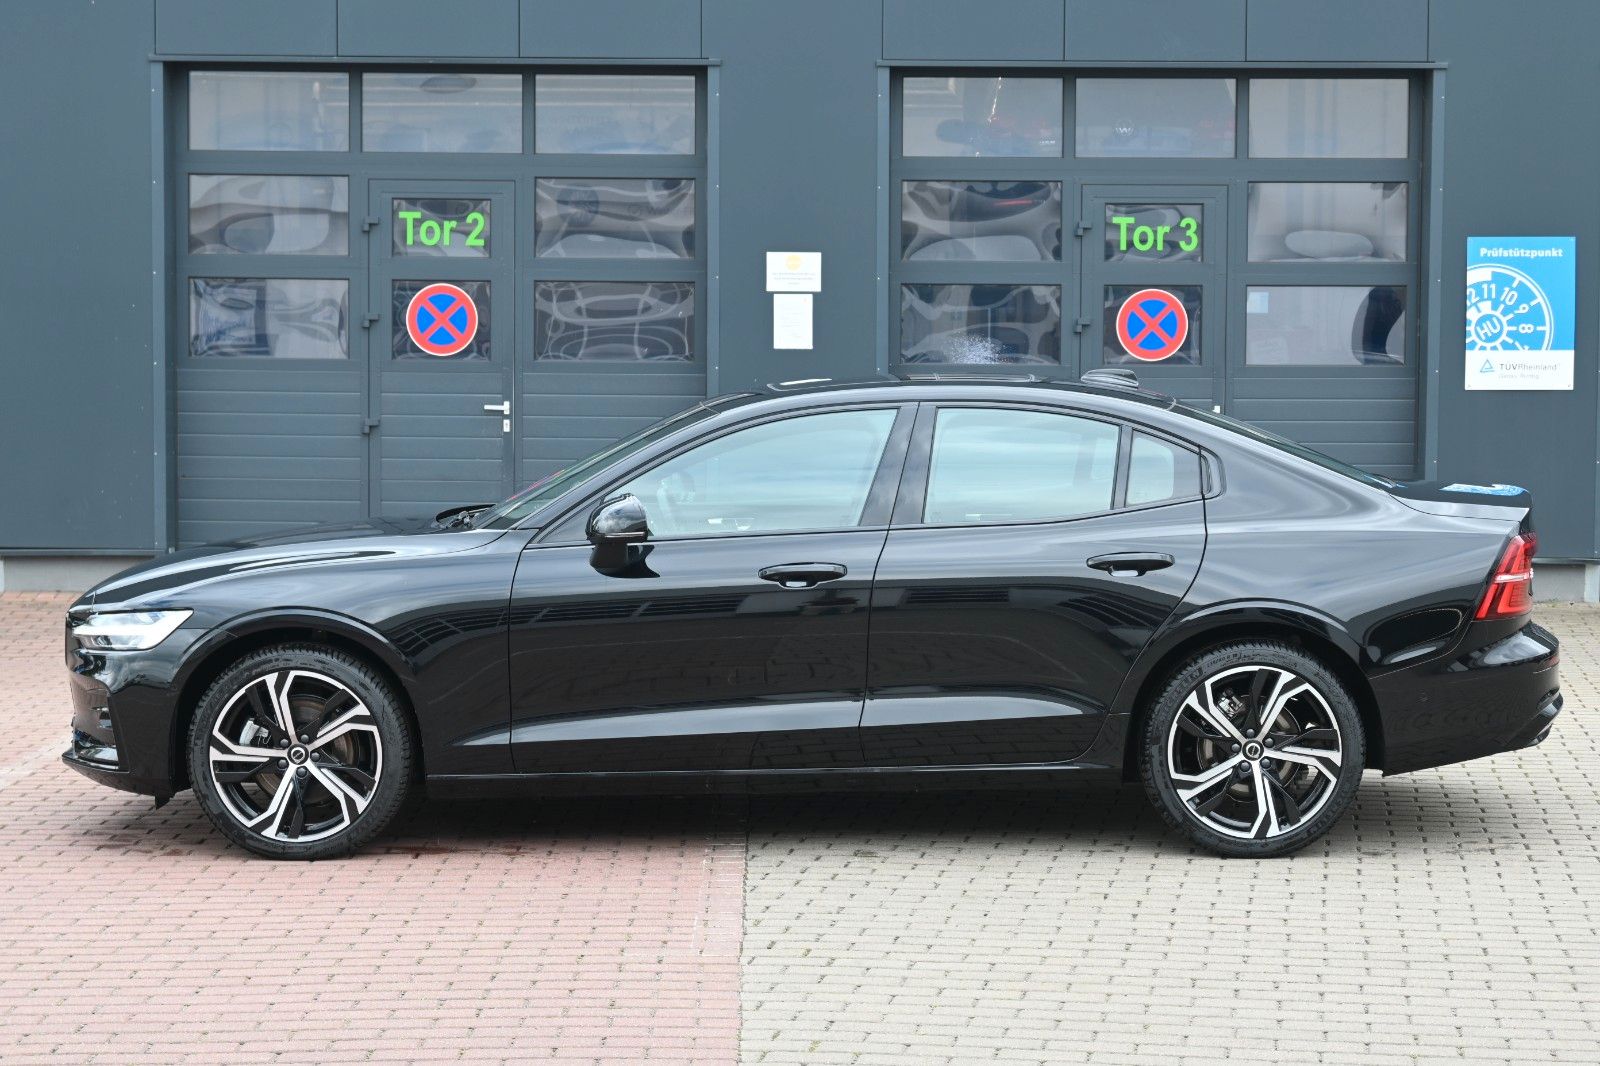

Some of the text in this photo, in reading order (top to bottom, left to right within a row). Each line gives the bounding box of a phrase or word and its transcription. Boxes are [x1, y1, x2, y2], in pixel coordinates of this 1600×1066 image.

[398, 211, 485, 246] Tor 2
[1112, 216, 1198, 252] Tor 3
[1479, 247, 1563, 259] Prüfstützpunkt
[1467, 283, 1535, 334] 2 11 10 9 8
[1476, 316, 1501, 340] HU
